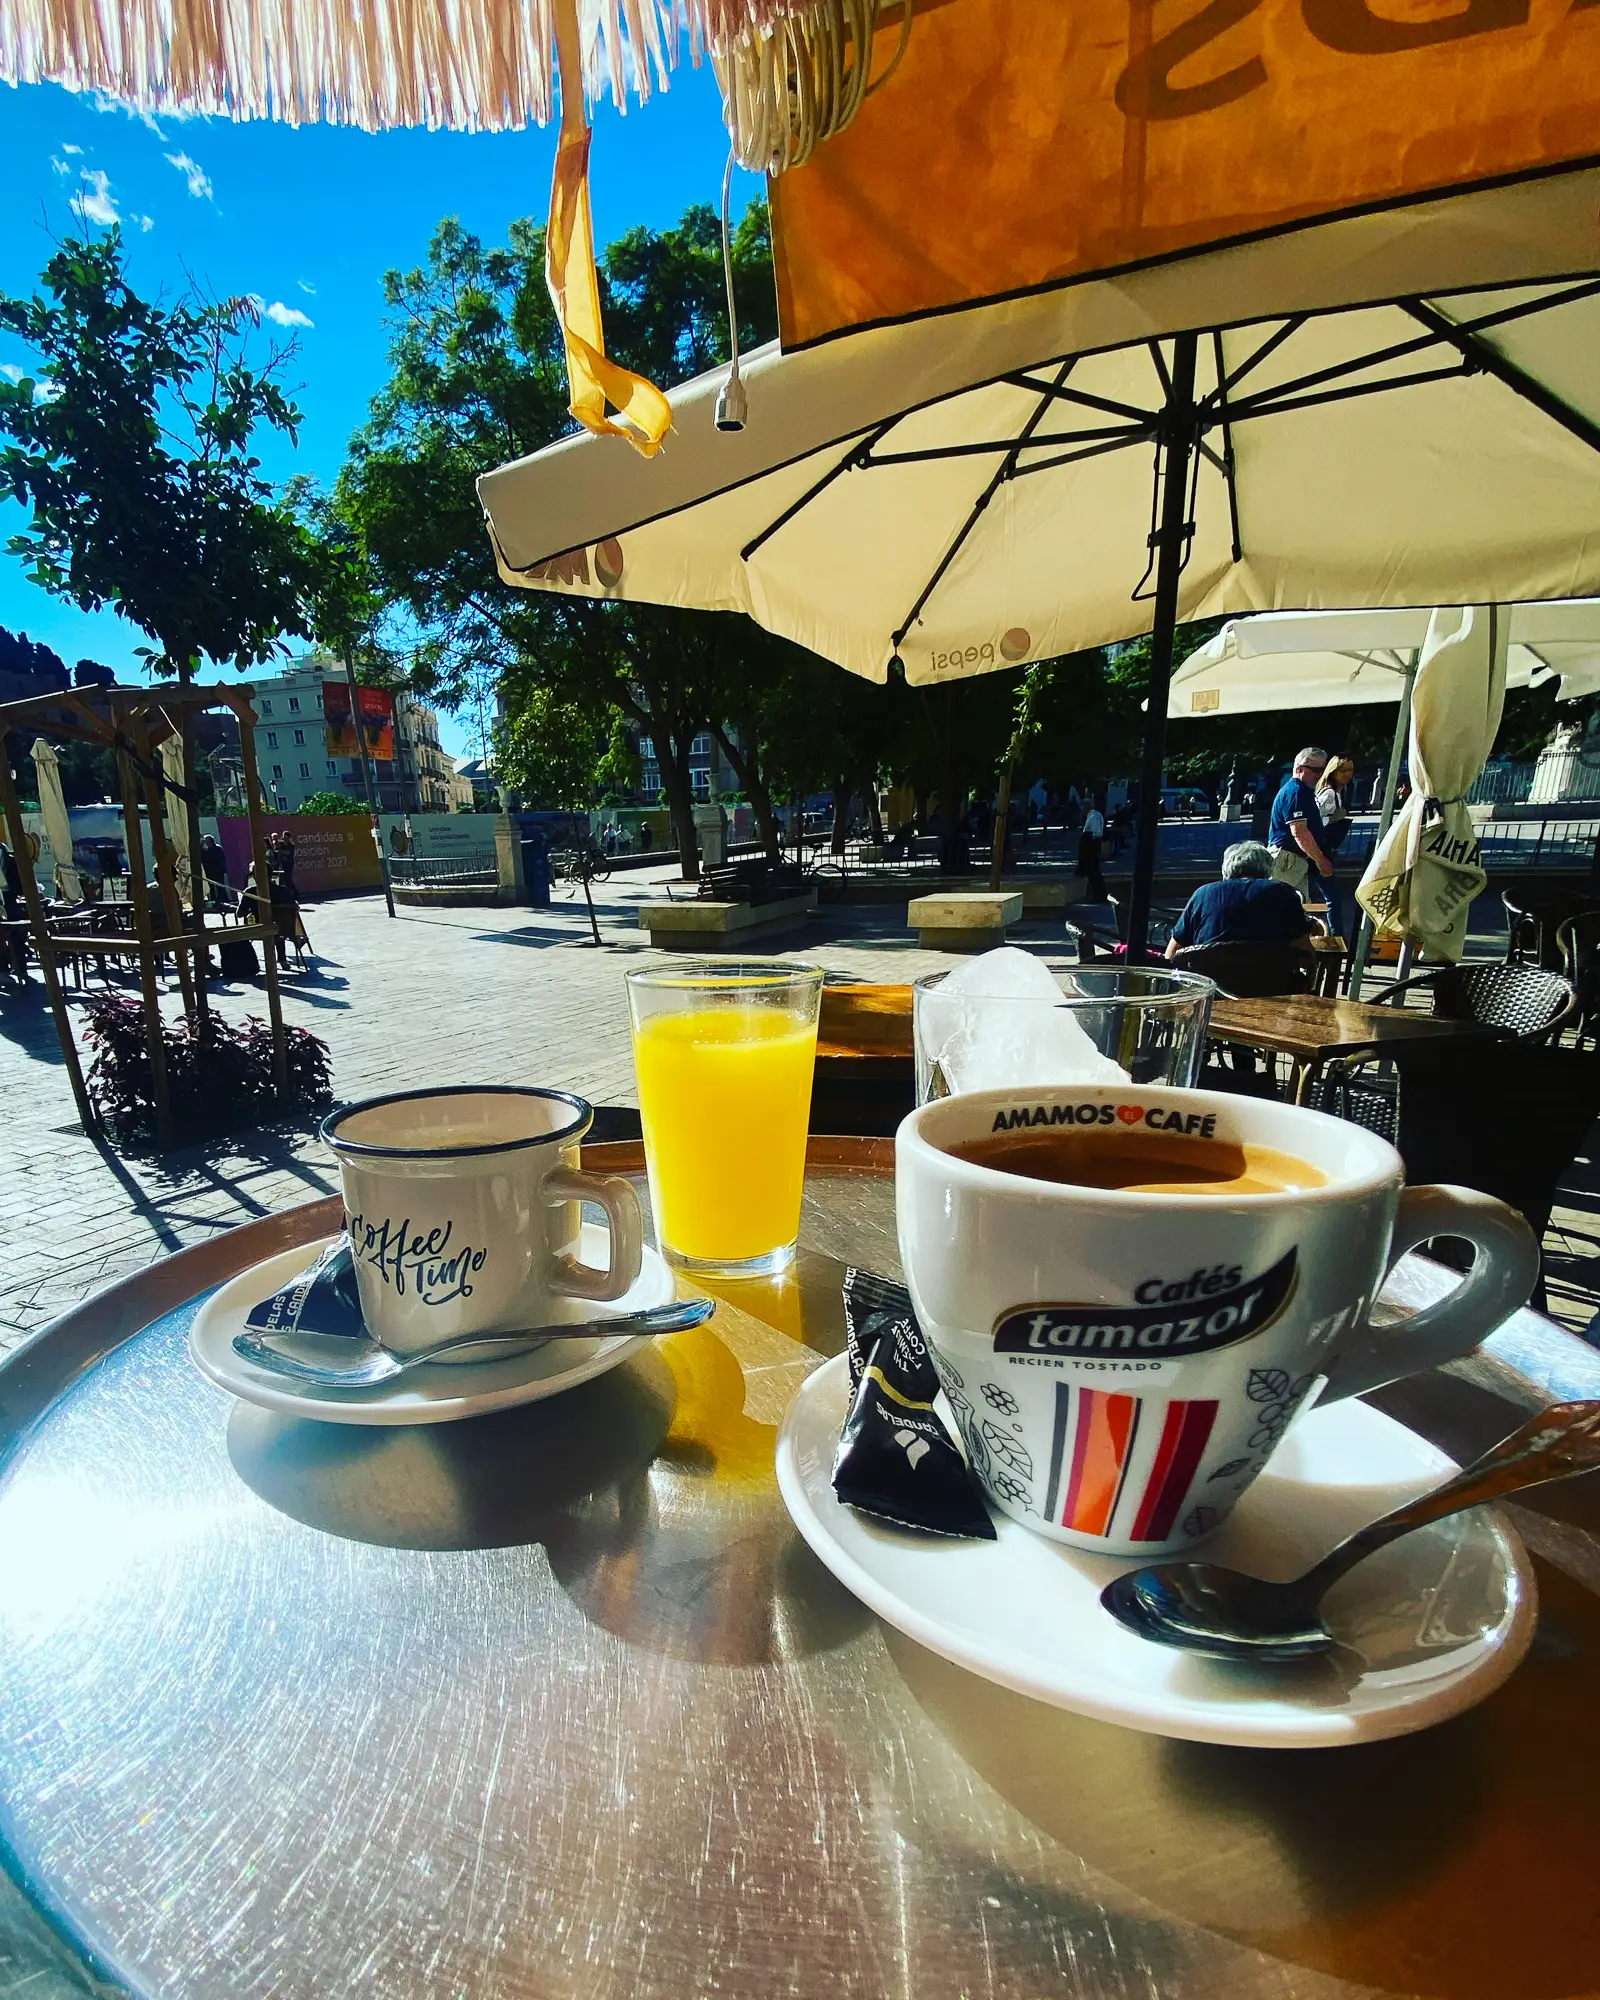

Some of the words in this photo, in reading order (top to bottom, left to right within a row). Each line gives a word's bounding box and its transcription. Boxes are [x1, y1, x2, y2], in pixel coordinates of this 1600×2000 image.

[297, 832, 344, 844] candidata
[326, 857, 348, 868] 2027
[991, 1104, 1115, 1133] AMAMOS
[1144, 1108, 1217, 1138] CAFÉ
[351, 1214, 453, 1296] Coffee
[404, 1246, 488, 1306] Time
[1134, 1264, 1244, 1305] Cafés
[1027, 1286, 1264, 1349] tamazor
[1008, 1356, 1065, 1368] RECIEN
[1074, 1361, 1163, 1372] TOSTADO
[876, 1401, 940, 1436] CANDELAS
